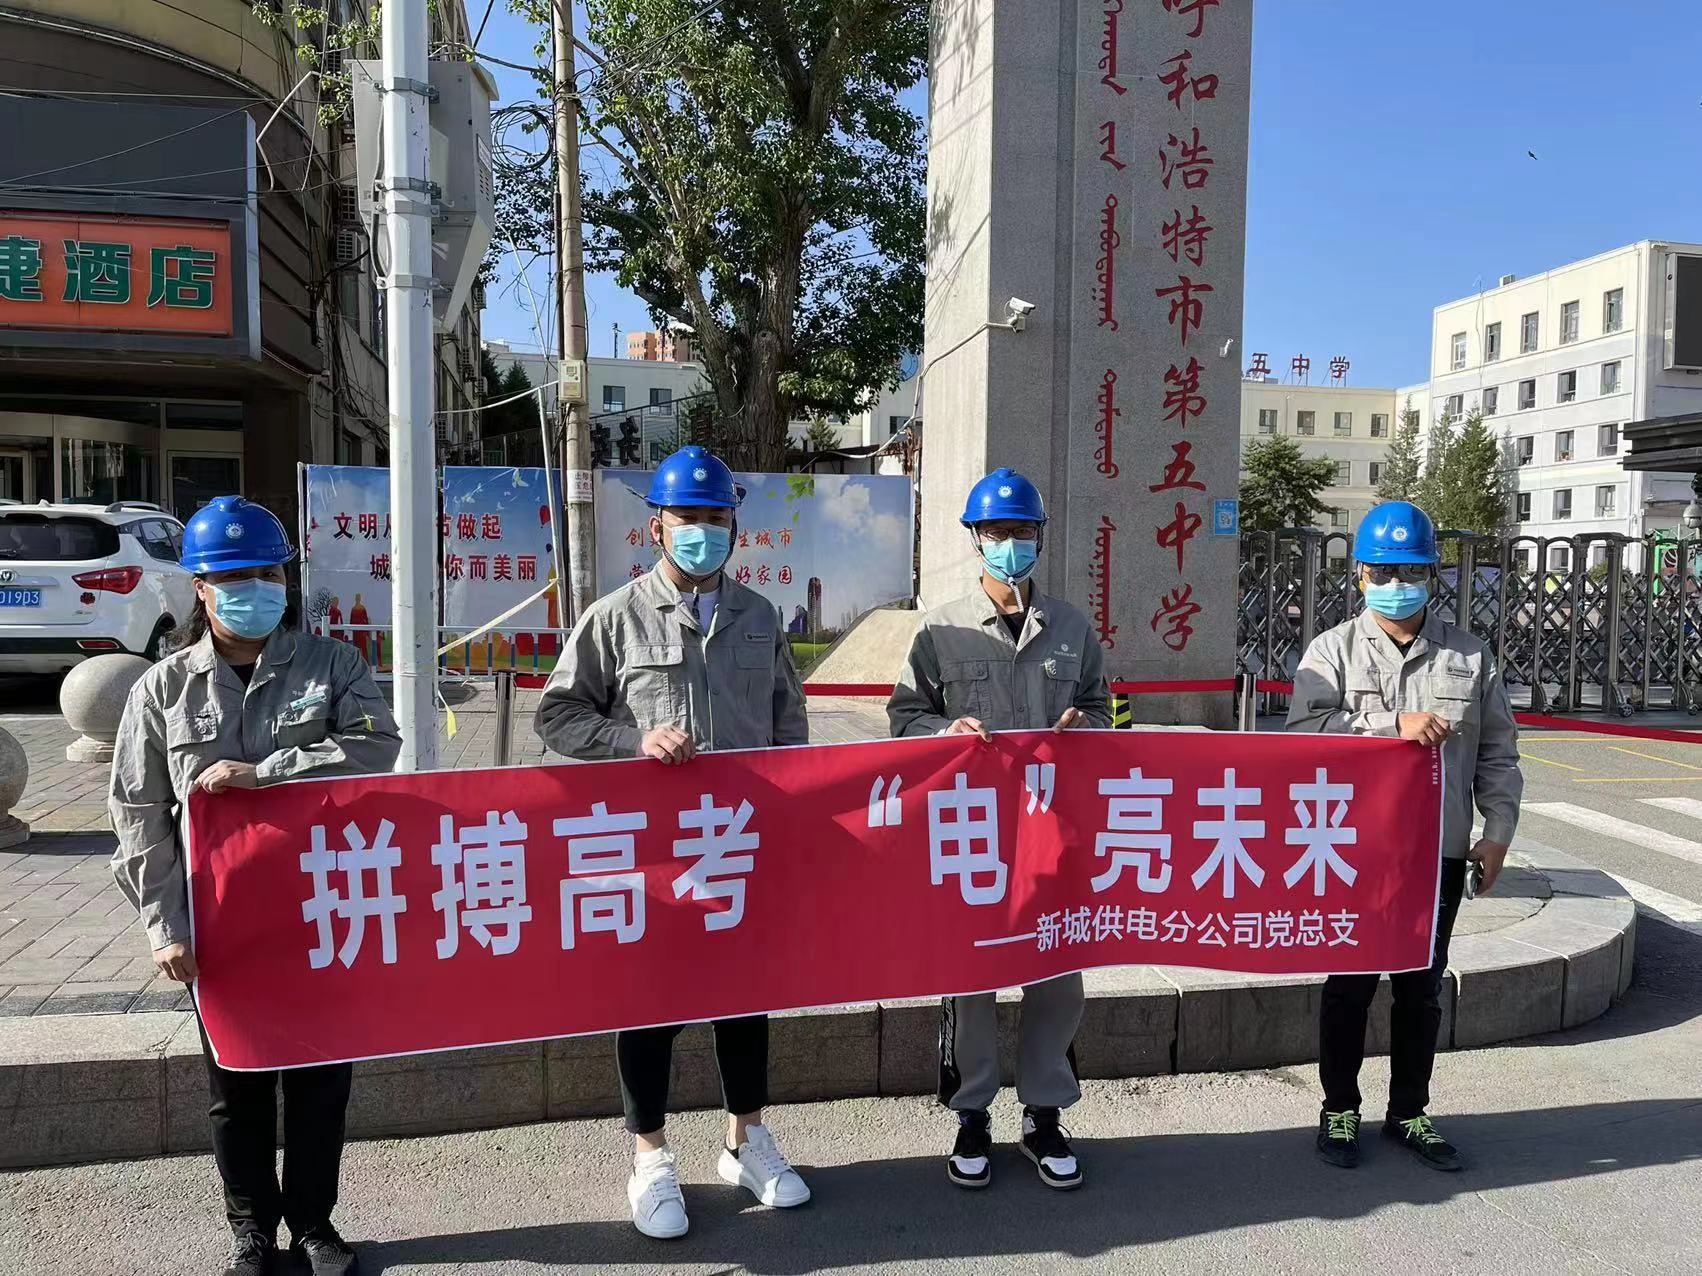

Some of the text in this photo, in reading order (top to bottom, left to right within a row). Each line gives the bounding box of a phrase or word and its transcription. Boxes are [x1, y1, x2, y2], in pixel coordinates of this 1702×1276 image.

[299, 763, 1359, 969] 拼搏高考 “电”亮未来
